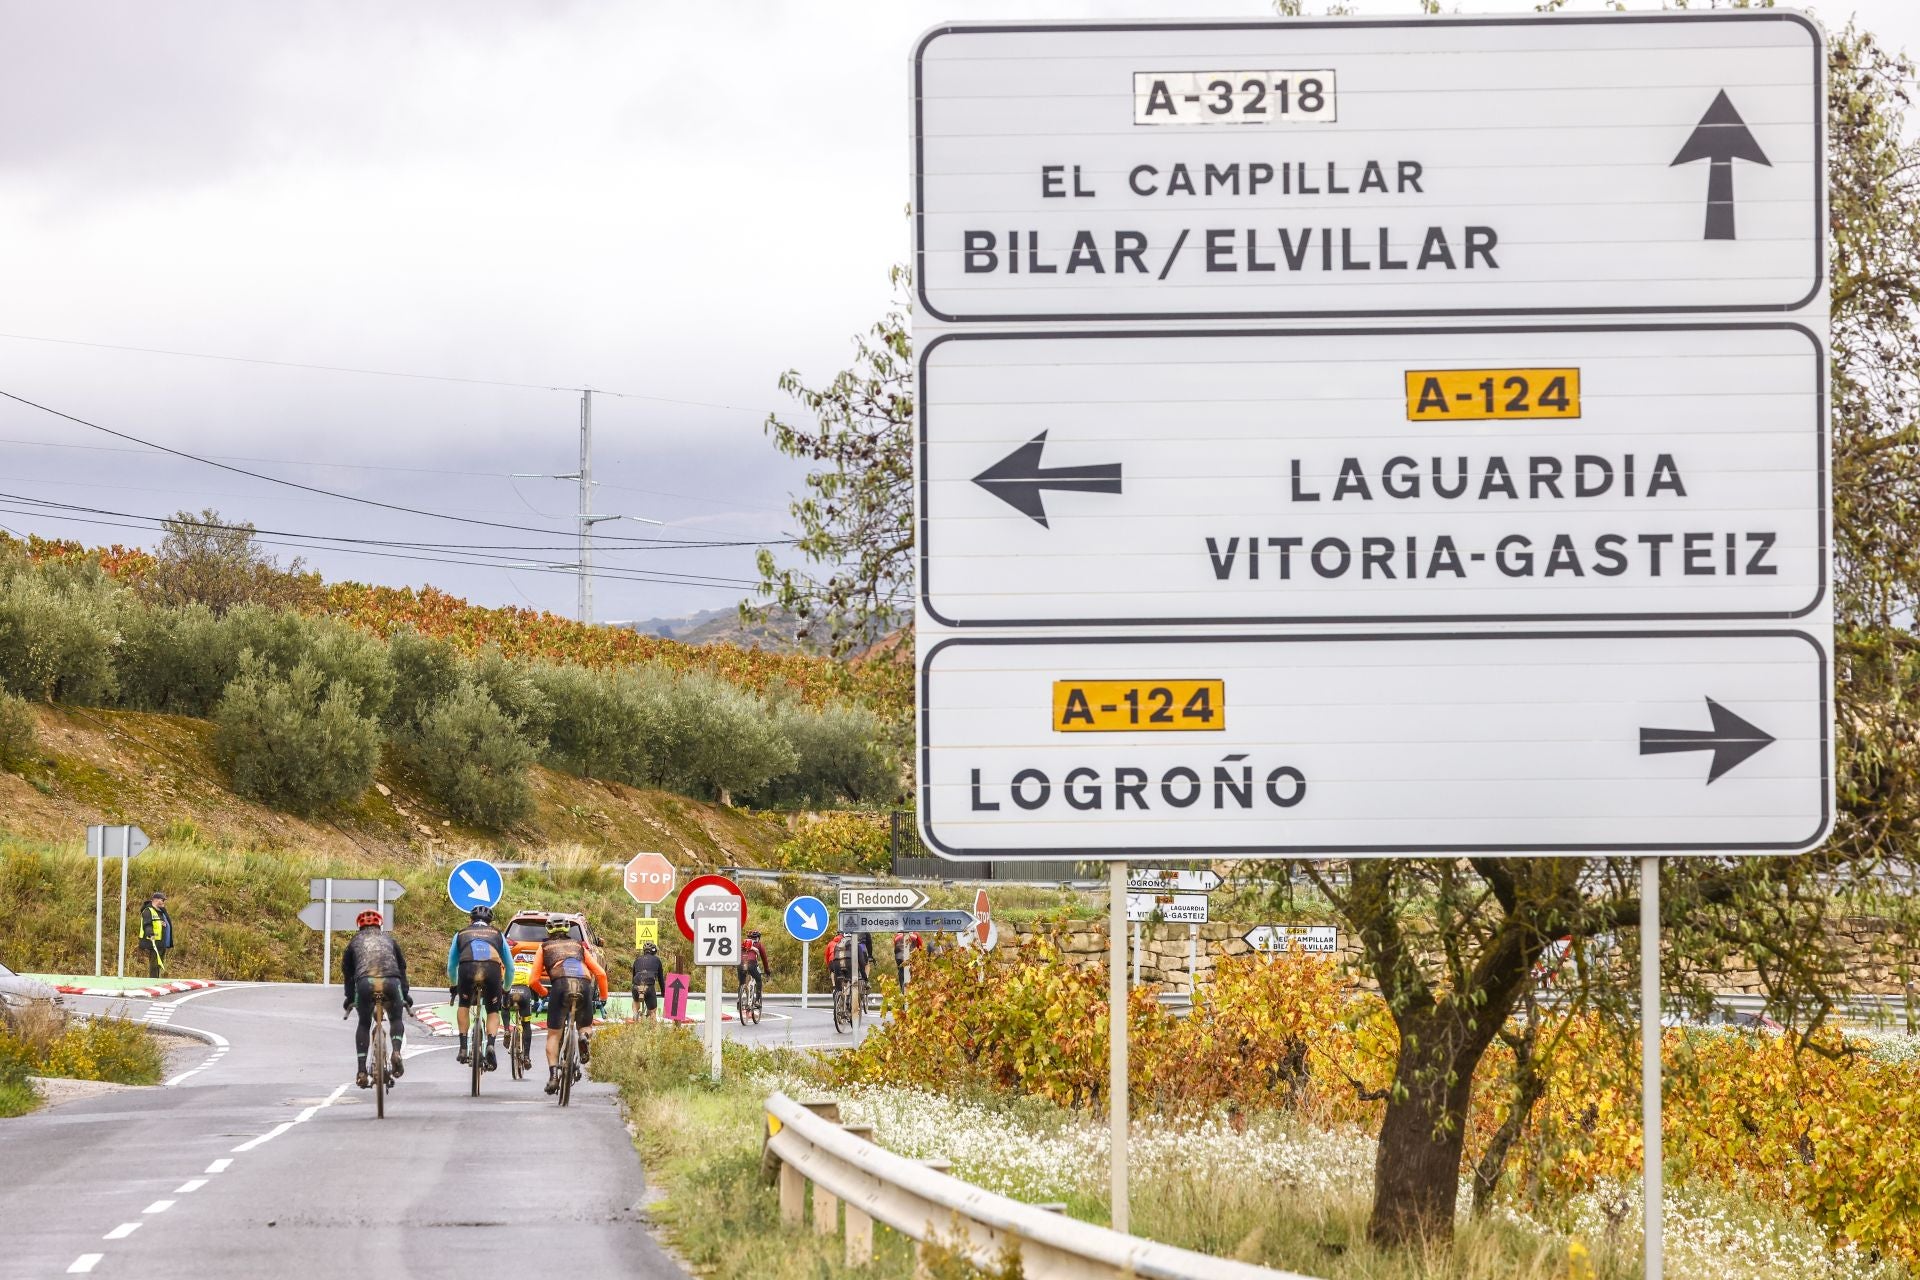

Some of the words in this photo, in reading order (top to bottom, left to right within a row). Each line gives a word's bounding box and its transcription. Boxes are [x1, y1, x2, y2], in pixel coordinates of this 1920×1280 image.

[1145, 78, 1325, 117] A-3218
[1042, 165, 1096, 198] EL
[1129, 160, 1424, 196] CAMPILLAR
[964, 225, 1500, 280] BILAR/ELVILLAR
[1416, 375, 1571, 413] A-124
[1291, 453, 1688, 502] LAGUARDIA
[1205, 532, 1779, 580] VITORIA-GASTEIZ
[1061, 687, 1214, 725] A-124
[971, 754, 1307, 811] LOGROÑO
[629, 872, 672, 884] STOP
[696, 902, 740, 912] A-4202
[841, 893, 852, 905] El
[857, 893, 909, 905] Redondo
[708, 923, 727, 933] km
[861, 917, 899, 928] Bodegas
[703, 937, 732, 957] 78
